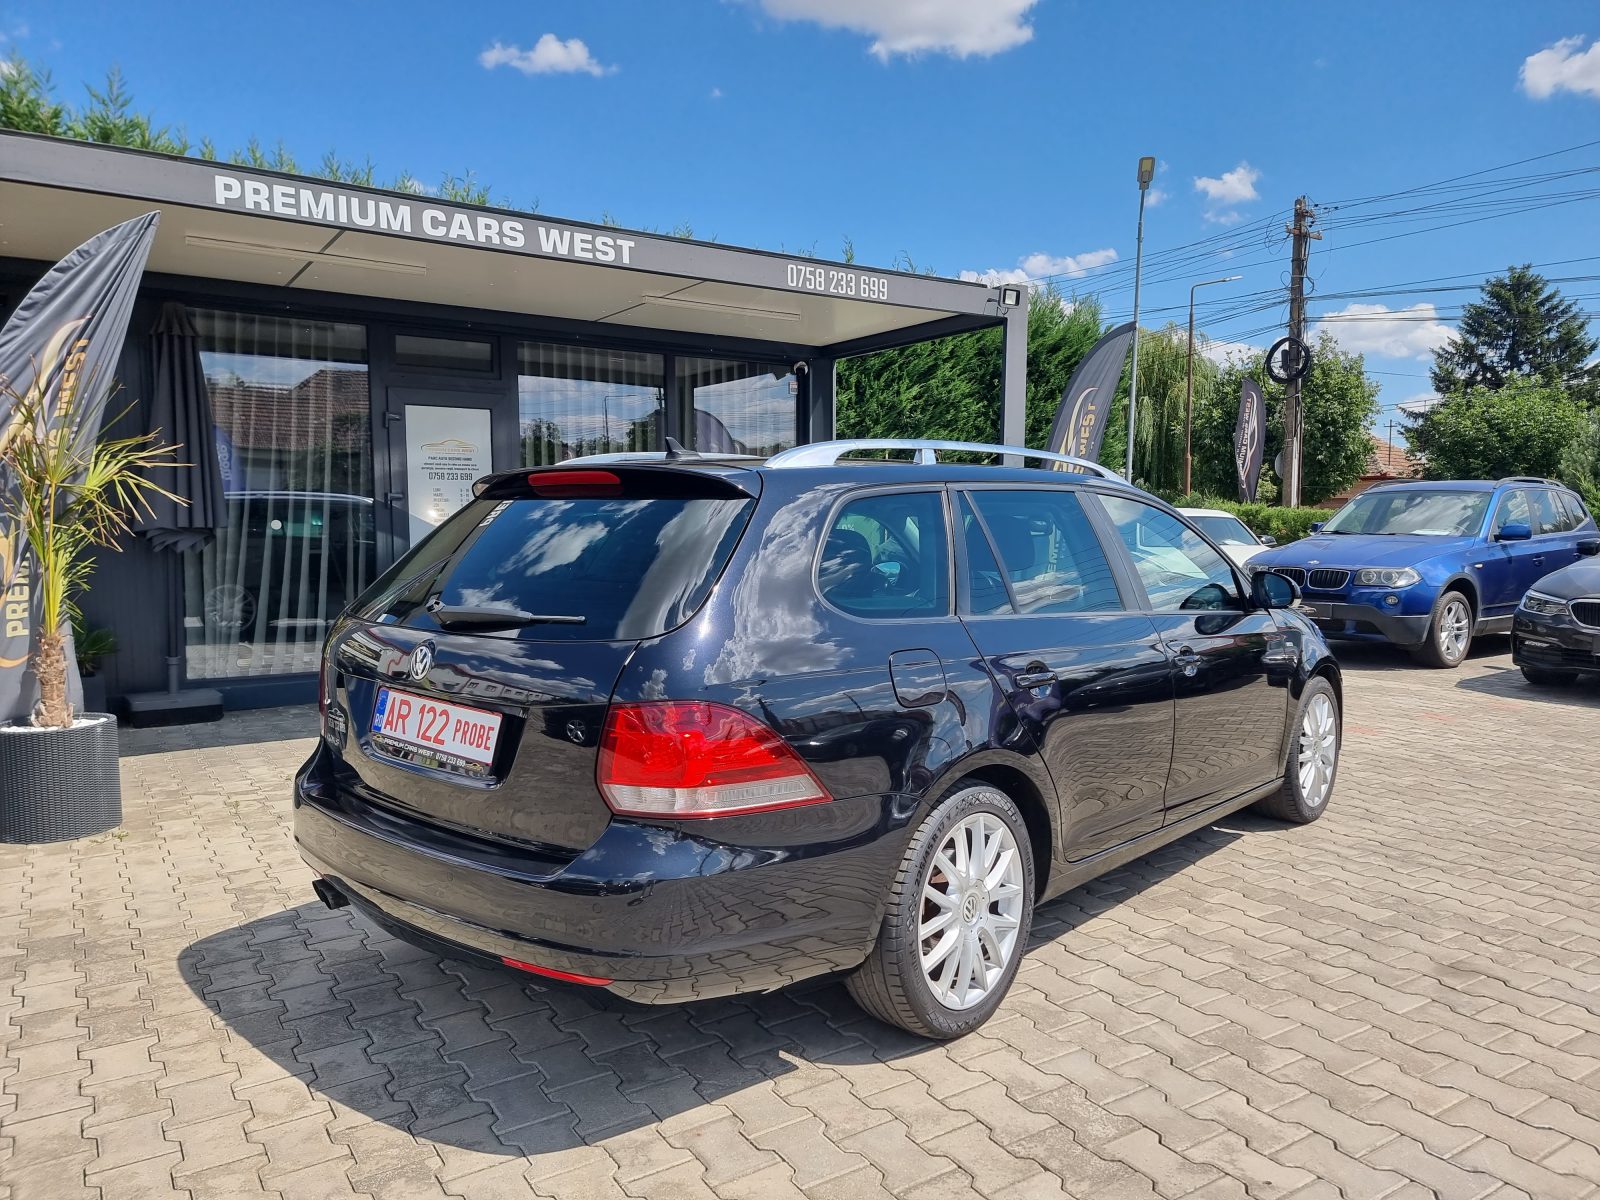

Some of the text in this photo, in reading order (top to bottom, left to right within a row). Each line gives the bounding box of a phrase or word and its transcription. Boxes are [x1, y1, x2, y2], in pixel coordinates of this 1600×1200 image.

[214, 174, 636, 265] PREMIUM CARS WEST
[787, 264, 888, 300] 0758 233 699
[428, 471, 473, 481] 0758 233 699
[374, 713, 385, 728] RO
[383, 696, 412, 735] AR
[416, 703, 450, 746] 122
[452, 718, 495, 751] PROBE
[384, 737, 405, 749] PREMIUM
[418, 748, 434, 757] WEST
[446, 755, 457, 765] 233
